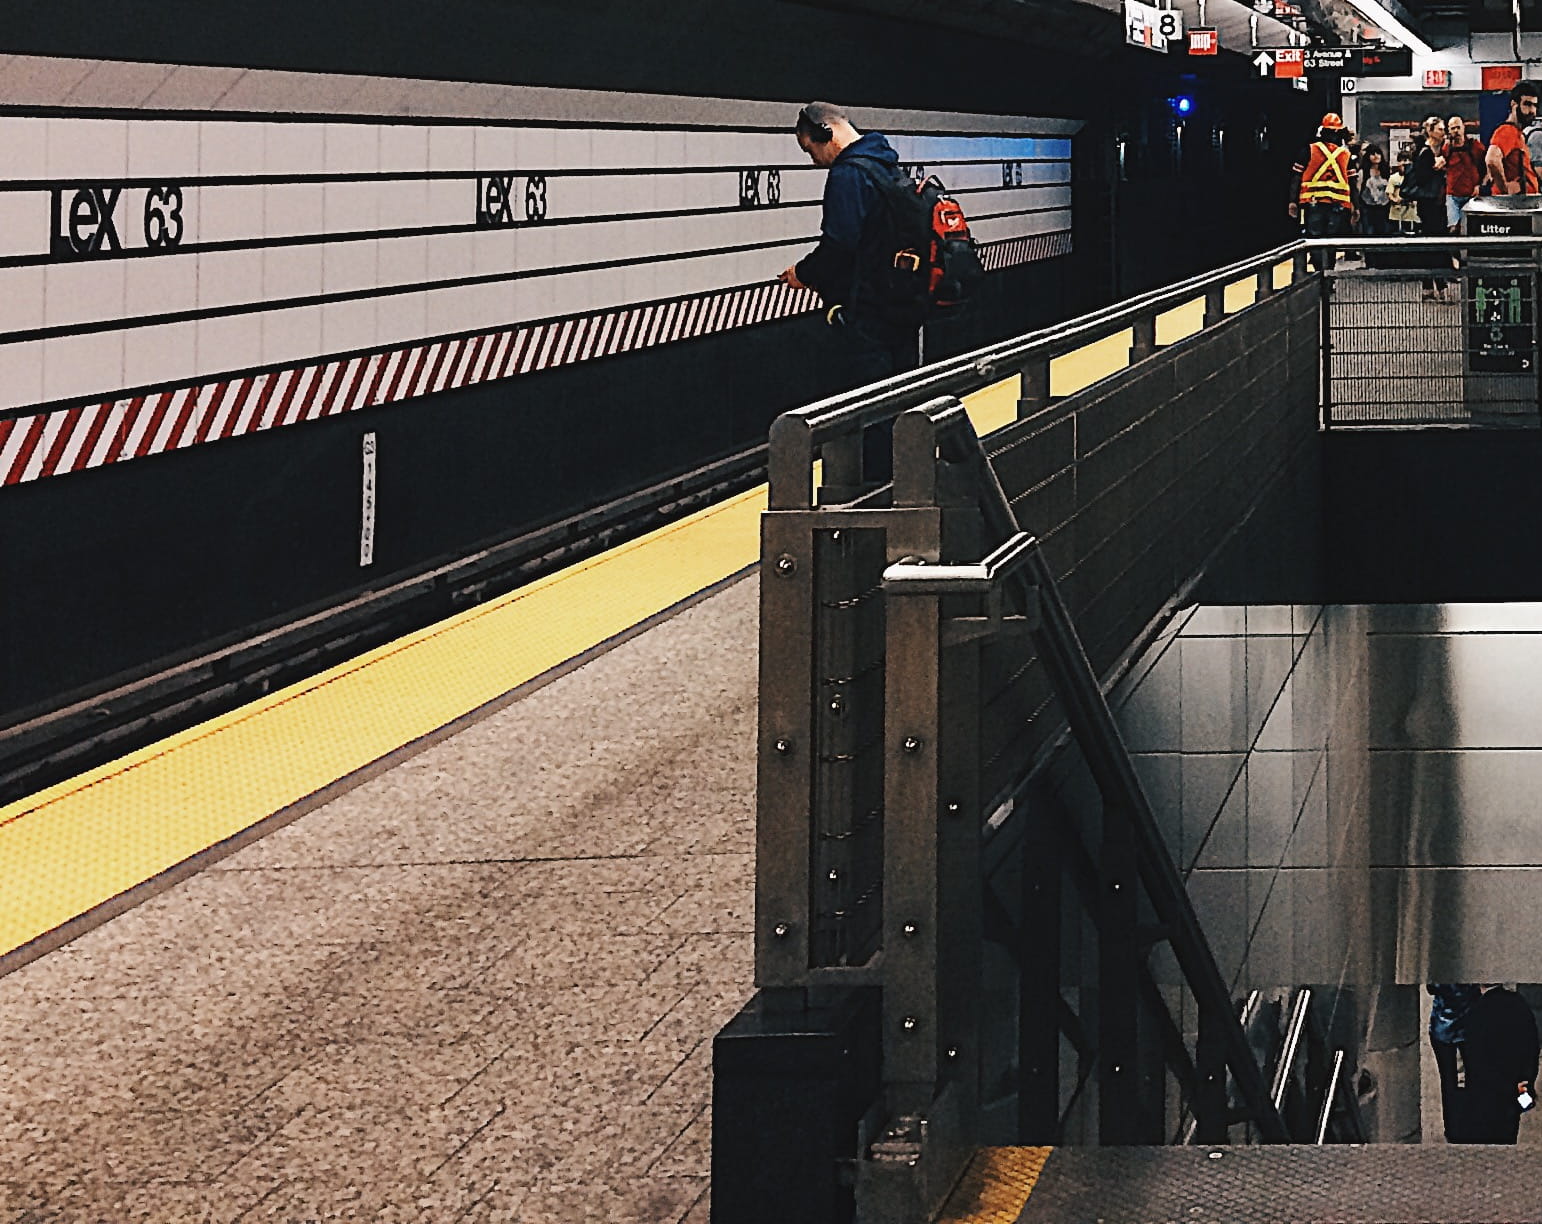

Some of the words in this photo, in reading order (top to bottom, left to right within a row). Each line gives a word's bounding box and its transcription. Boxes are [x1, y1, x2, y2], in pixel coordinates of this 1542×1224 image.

[1160, 14, 1176, 36] 8
[1275, 49, 1301, 62] Exit
[1318, 59, 1344, 67] Street
[1341, 79, 1355, 92] 10
[476, 176, 514, 224] Lex
[526, 175, 547, 222] 63
[50, 184, 122, 254] Lex
[144, 183, 184, 250] 63
[1480, 224, 1511, 234] Litter
